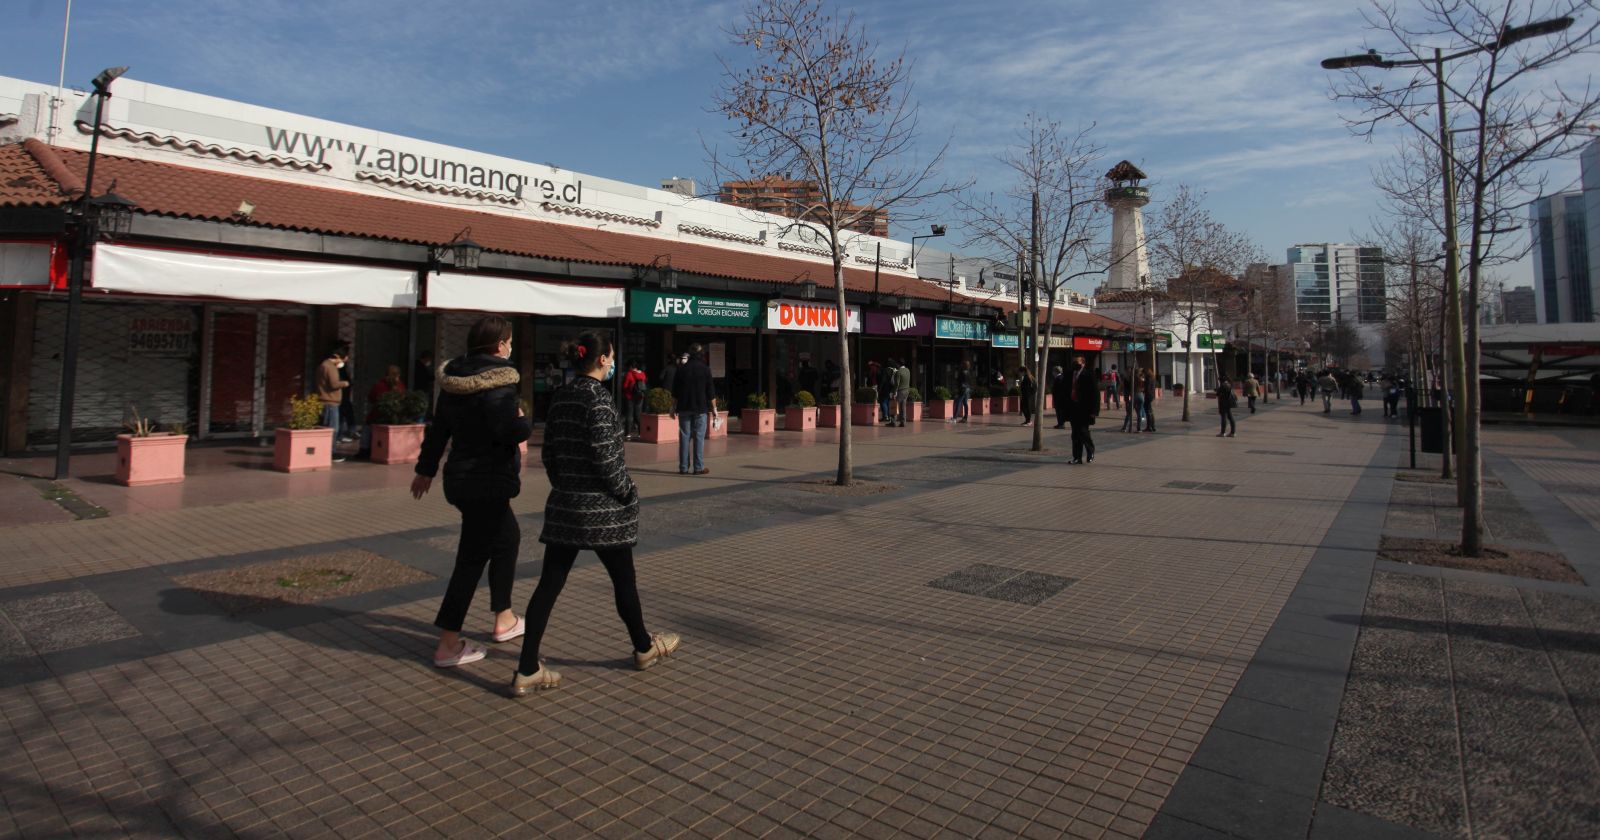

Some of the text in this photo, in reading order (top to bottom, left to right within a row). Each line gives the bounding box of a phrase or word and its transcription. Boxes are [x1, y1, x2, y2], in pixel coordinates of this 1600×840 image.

[654, 297, 692, 314] AFEX
[697, 308, 749, 317] FOREIGN EXCHANGE
[780, 303, 851, 327] DUNKI'
[892, 312, 916, 333] WOM
